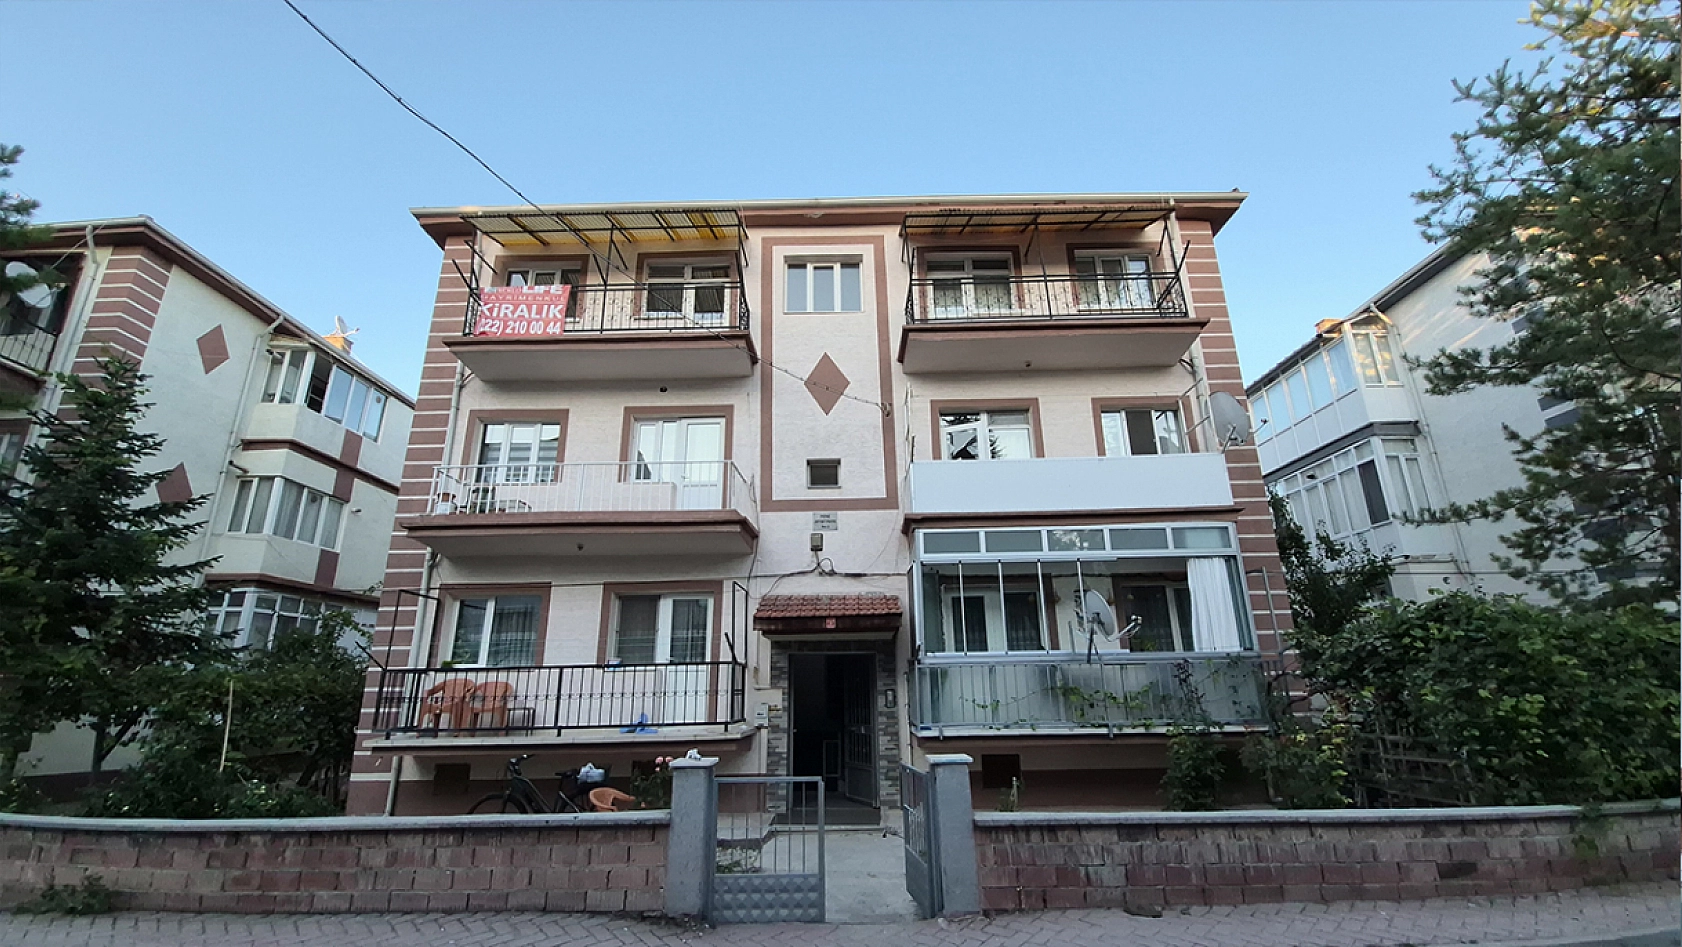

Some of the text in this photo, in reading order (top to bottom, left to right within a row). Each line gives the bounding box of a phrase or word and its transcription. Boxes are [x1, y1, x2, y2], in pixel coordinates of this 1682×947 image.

[506, 320, 528, 335] 210
[530, 321, 544, 335] 00
[546, 321, 561, 335] 44
